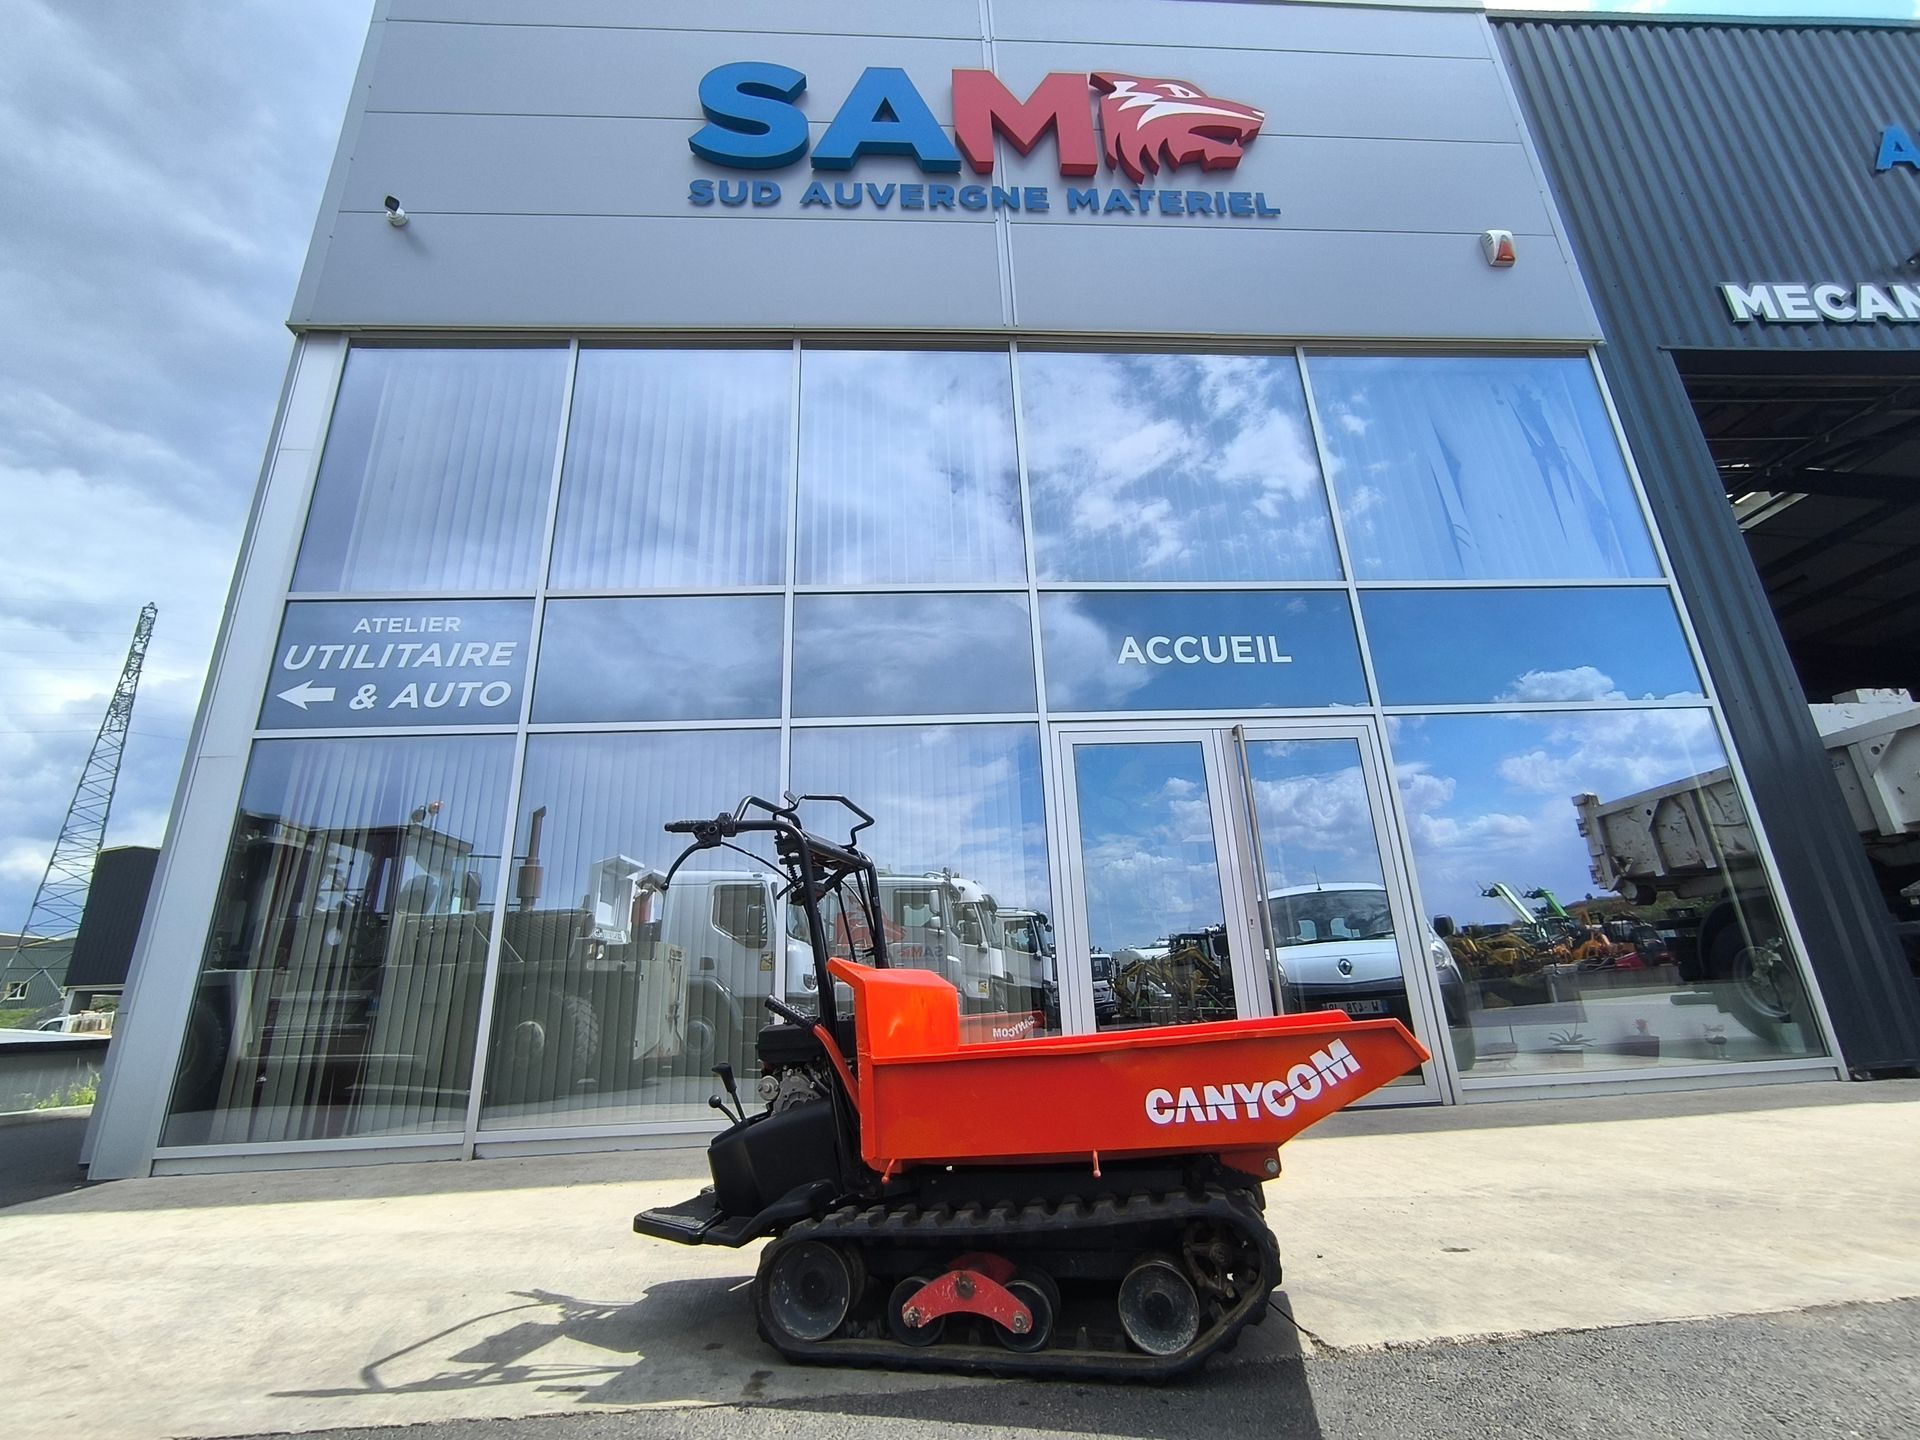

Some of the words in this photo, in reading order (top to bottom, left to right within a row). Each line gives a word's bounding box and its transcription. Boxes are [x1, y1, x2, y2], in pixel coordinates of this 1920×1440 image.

[688, 61, 1097, 177] SAM
[688, 179, 782, 207] SUD
[799, 181, 1050, 211] AUVERGNE
[1066, 187, 1282, 216] MATERIEL
[352, 616, 463, 634] ATELIER
[282, 641, 518, 671] UTILITAIRE
[1117, 635, 1293, 665] ACCUEIL
[348, 683, 379, 711] &
[387, 680, 512, 709] AUTO
[1145, 1038, 1361, 1124] CANYCOM
